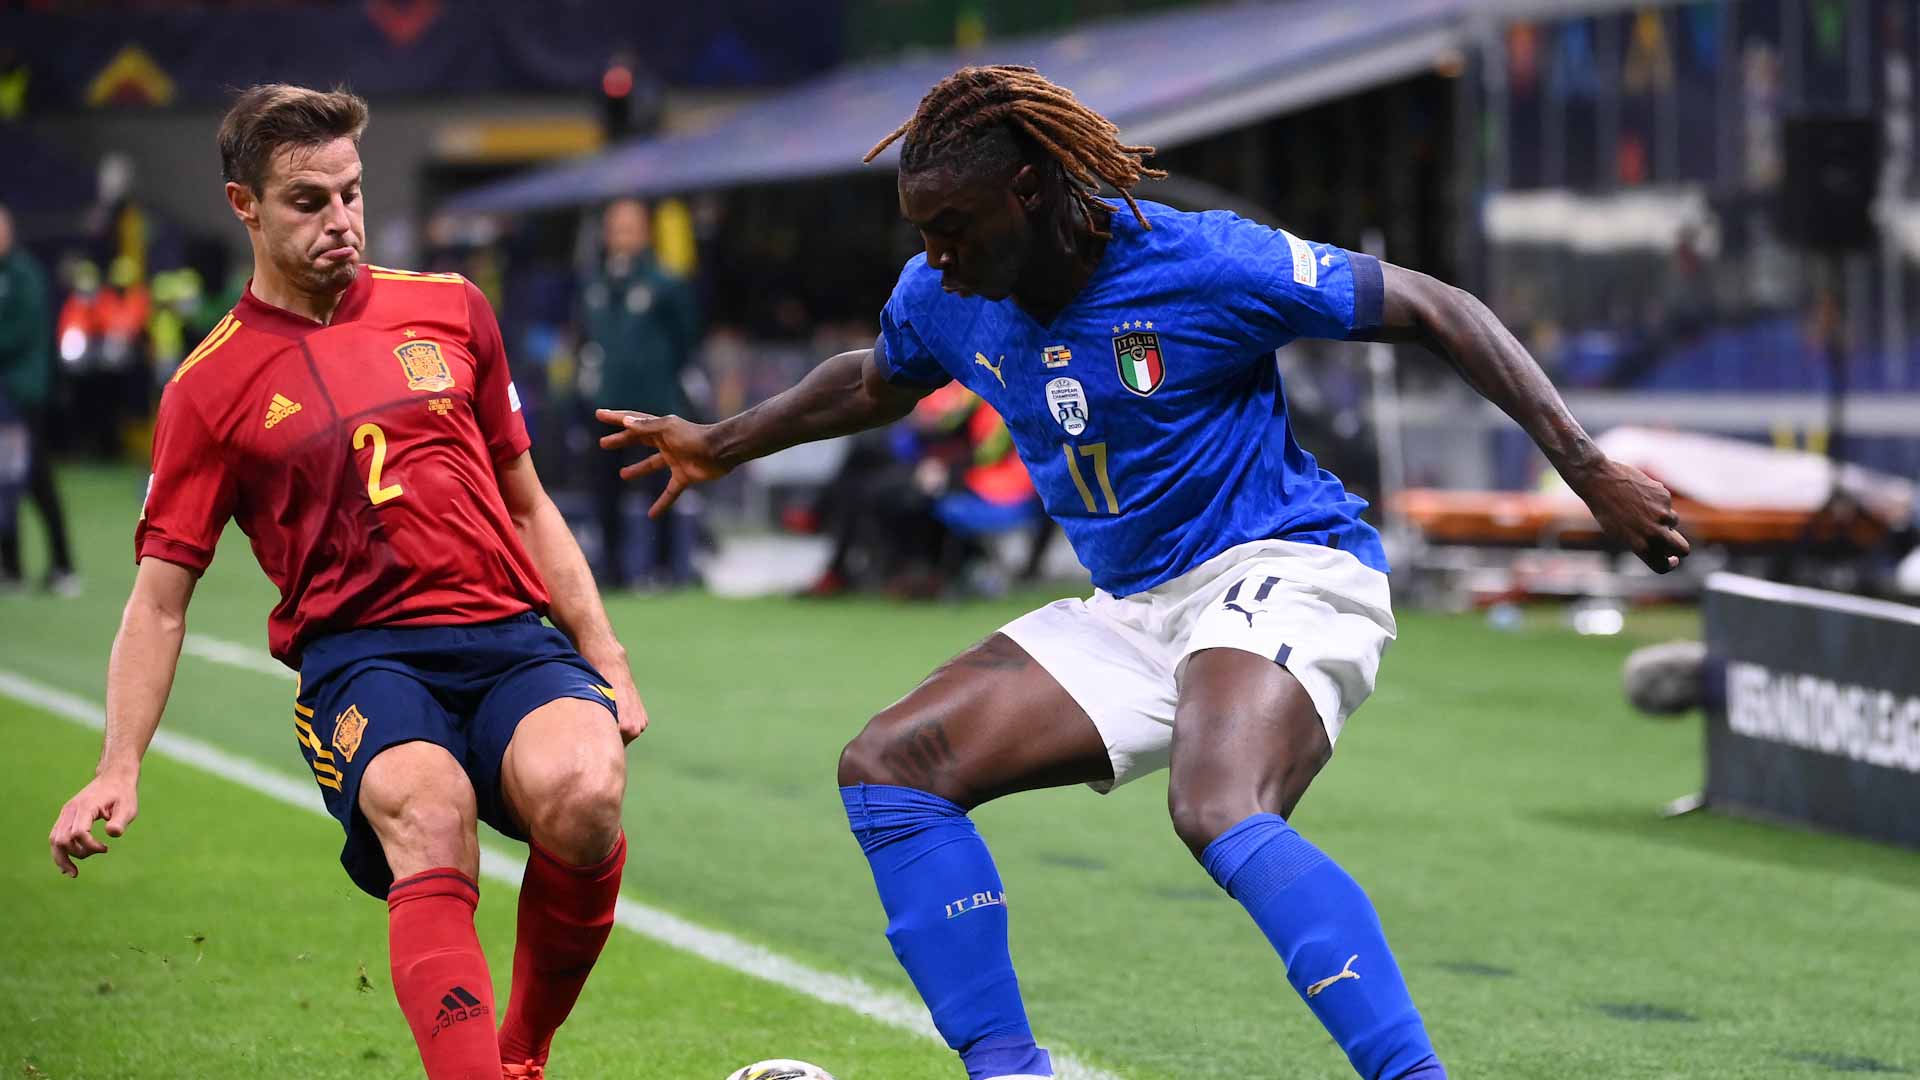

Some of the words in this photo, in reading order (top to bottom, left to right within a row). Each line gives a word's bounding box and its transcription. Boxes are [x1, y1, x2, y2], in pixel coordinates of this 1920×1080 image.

[1117, 335, 1155, 350] ITALIA
[264, 402, 302, 429] adidas
[352, 423, 404, 505] 2
[1062, 442, 1119, 514] 17
[431, 1005, 489, 1040] adidas
